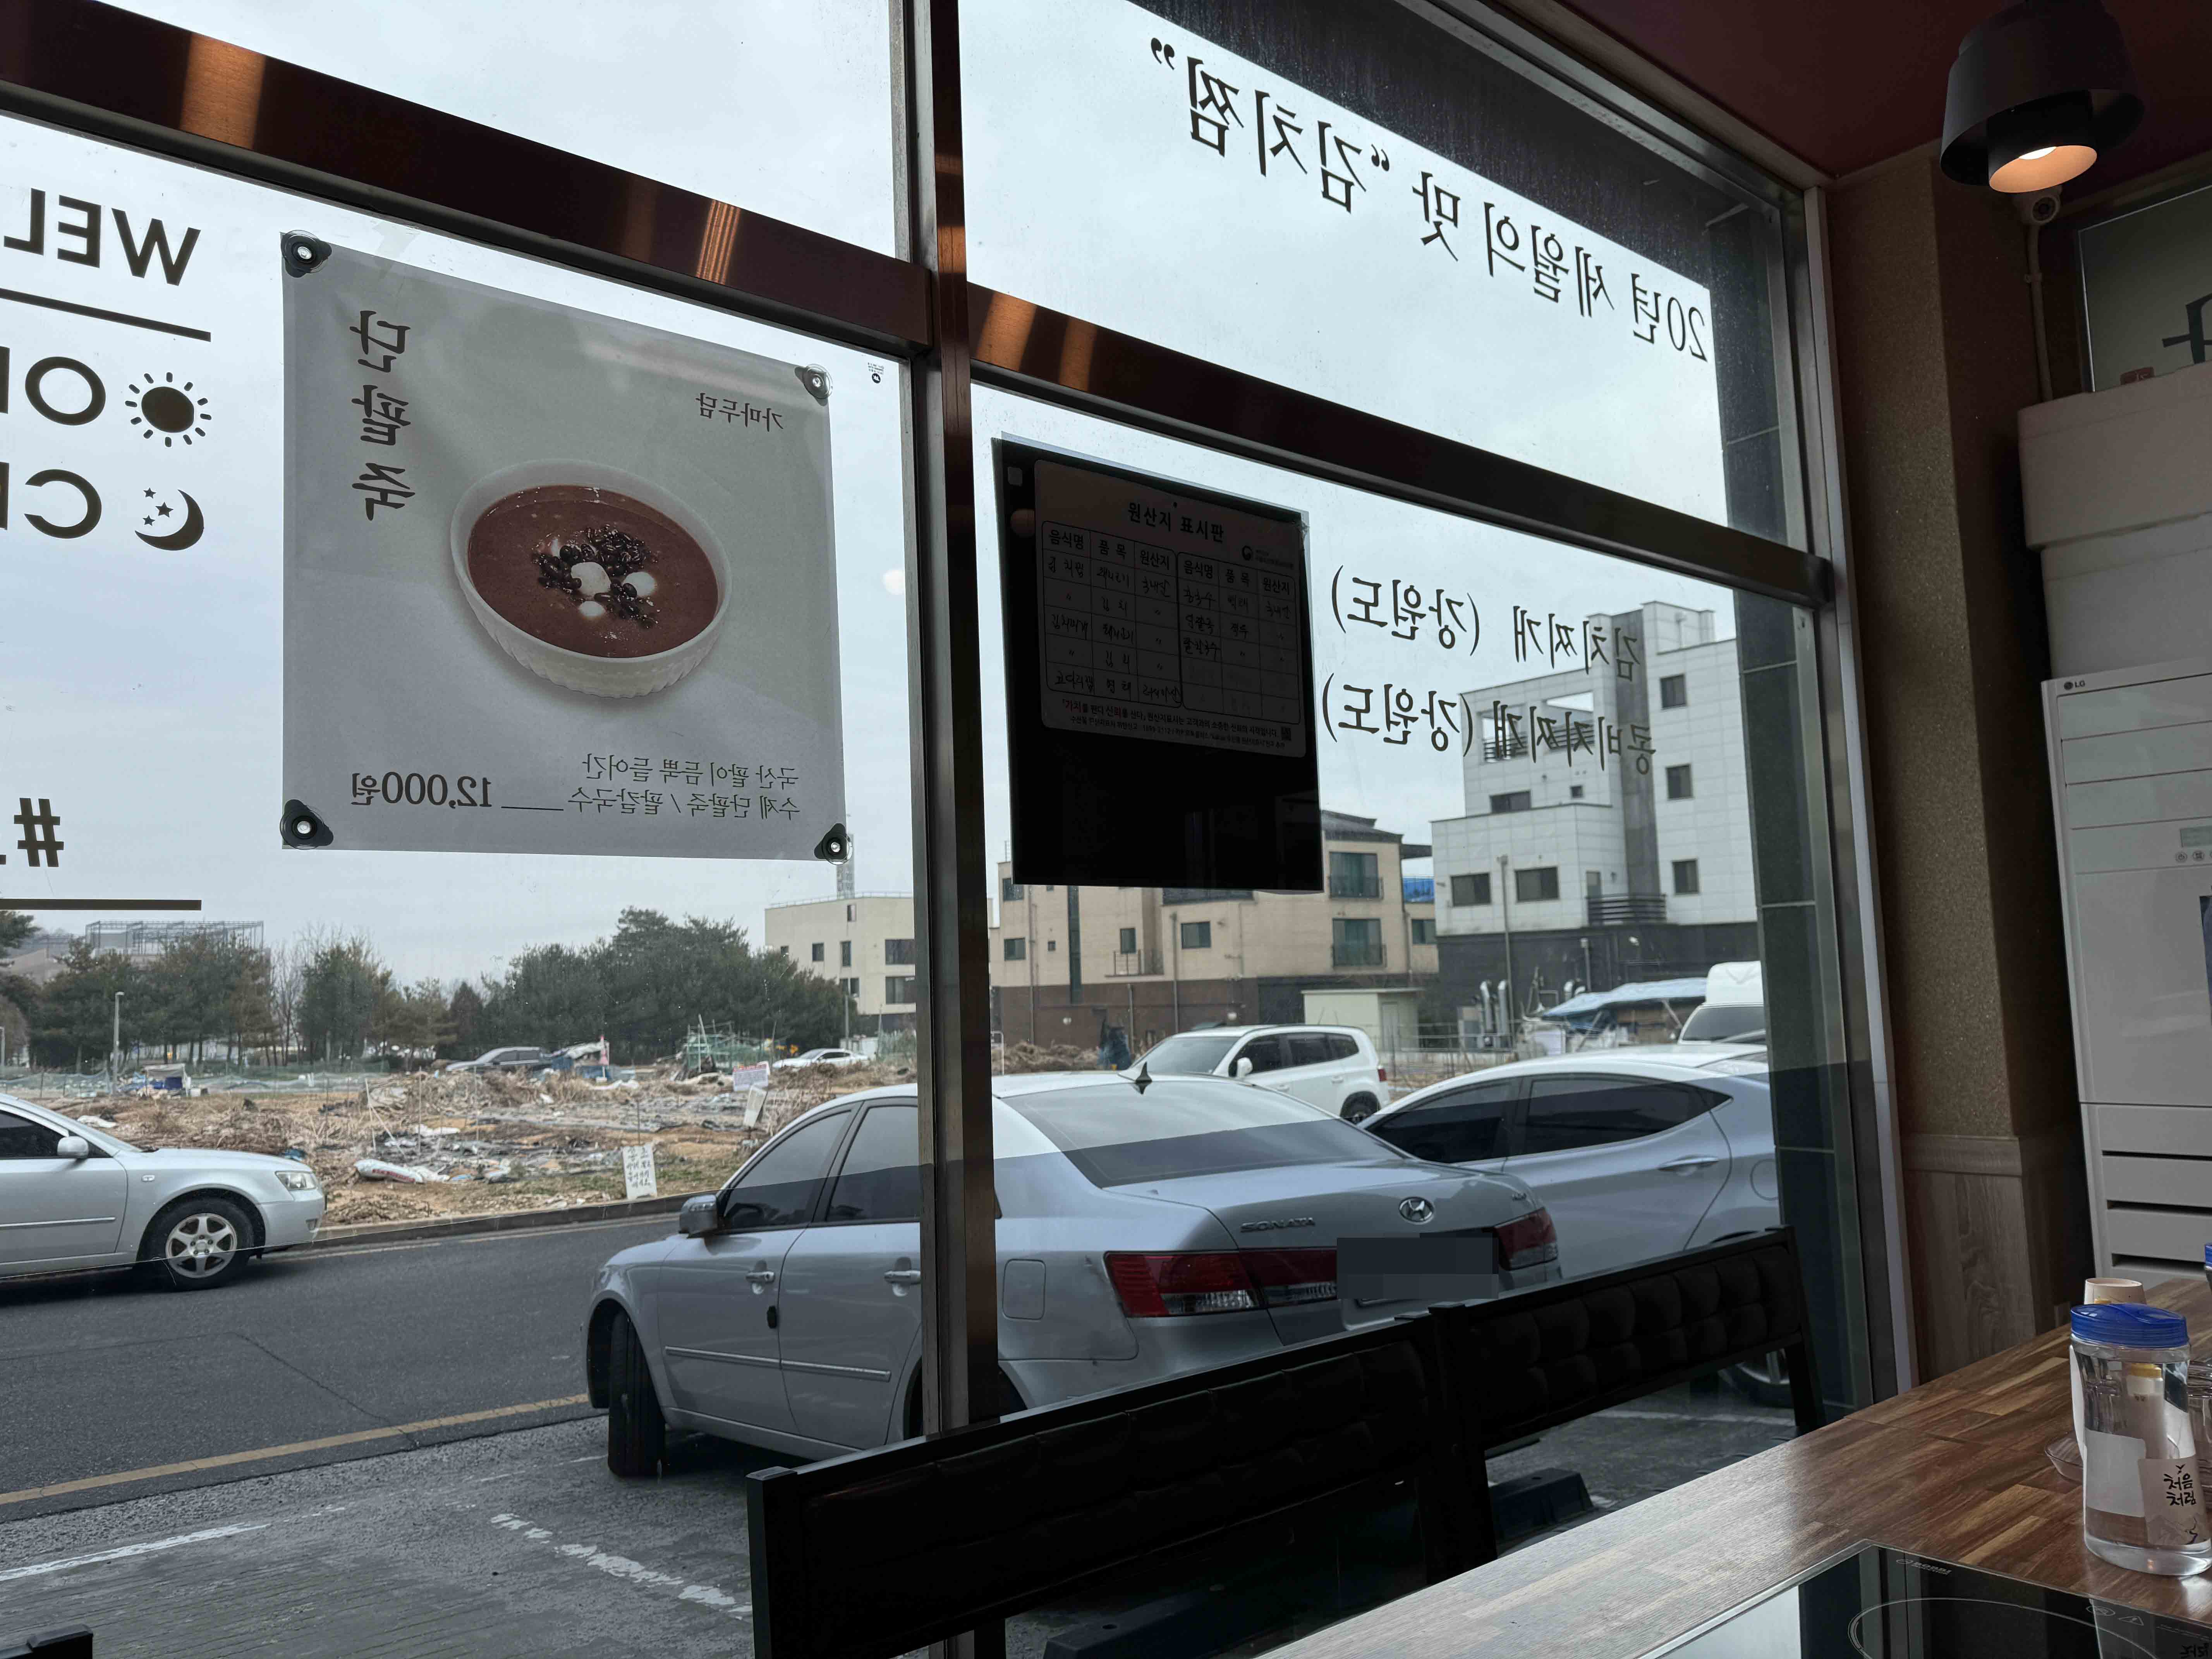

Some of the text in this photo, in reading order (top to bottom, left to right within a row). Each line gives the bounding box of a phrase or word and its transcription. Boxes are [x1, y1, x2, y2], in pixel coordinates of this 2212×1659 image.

[1128, 502, 1224, 543] 원산지 표시판
[1049, 529, 1084, 550] 음식명
[1140, 549, 1170, 570] 원산지
[1184, 560, 1213, 579] 음식명
[1263, 577, 1290, 595] 원산지
[1240, 1217, 1316, 1233] SONATA
[2163, 1473, 2193, 1491] 처음
[2166, 1490, 2197, 1506] 처럼
